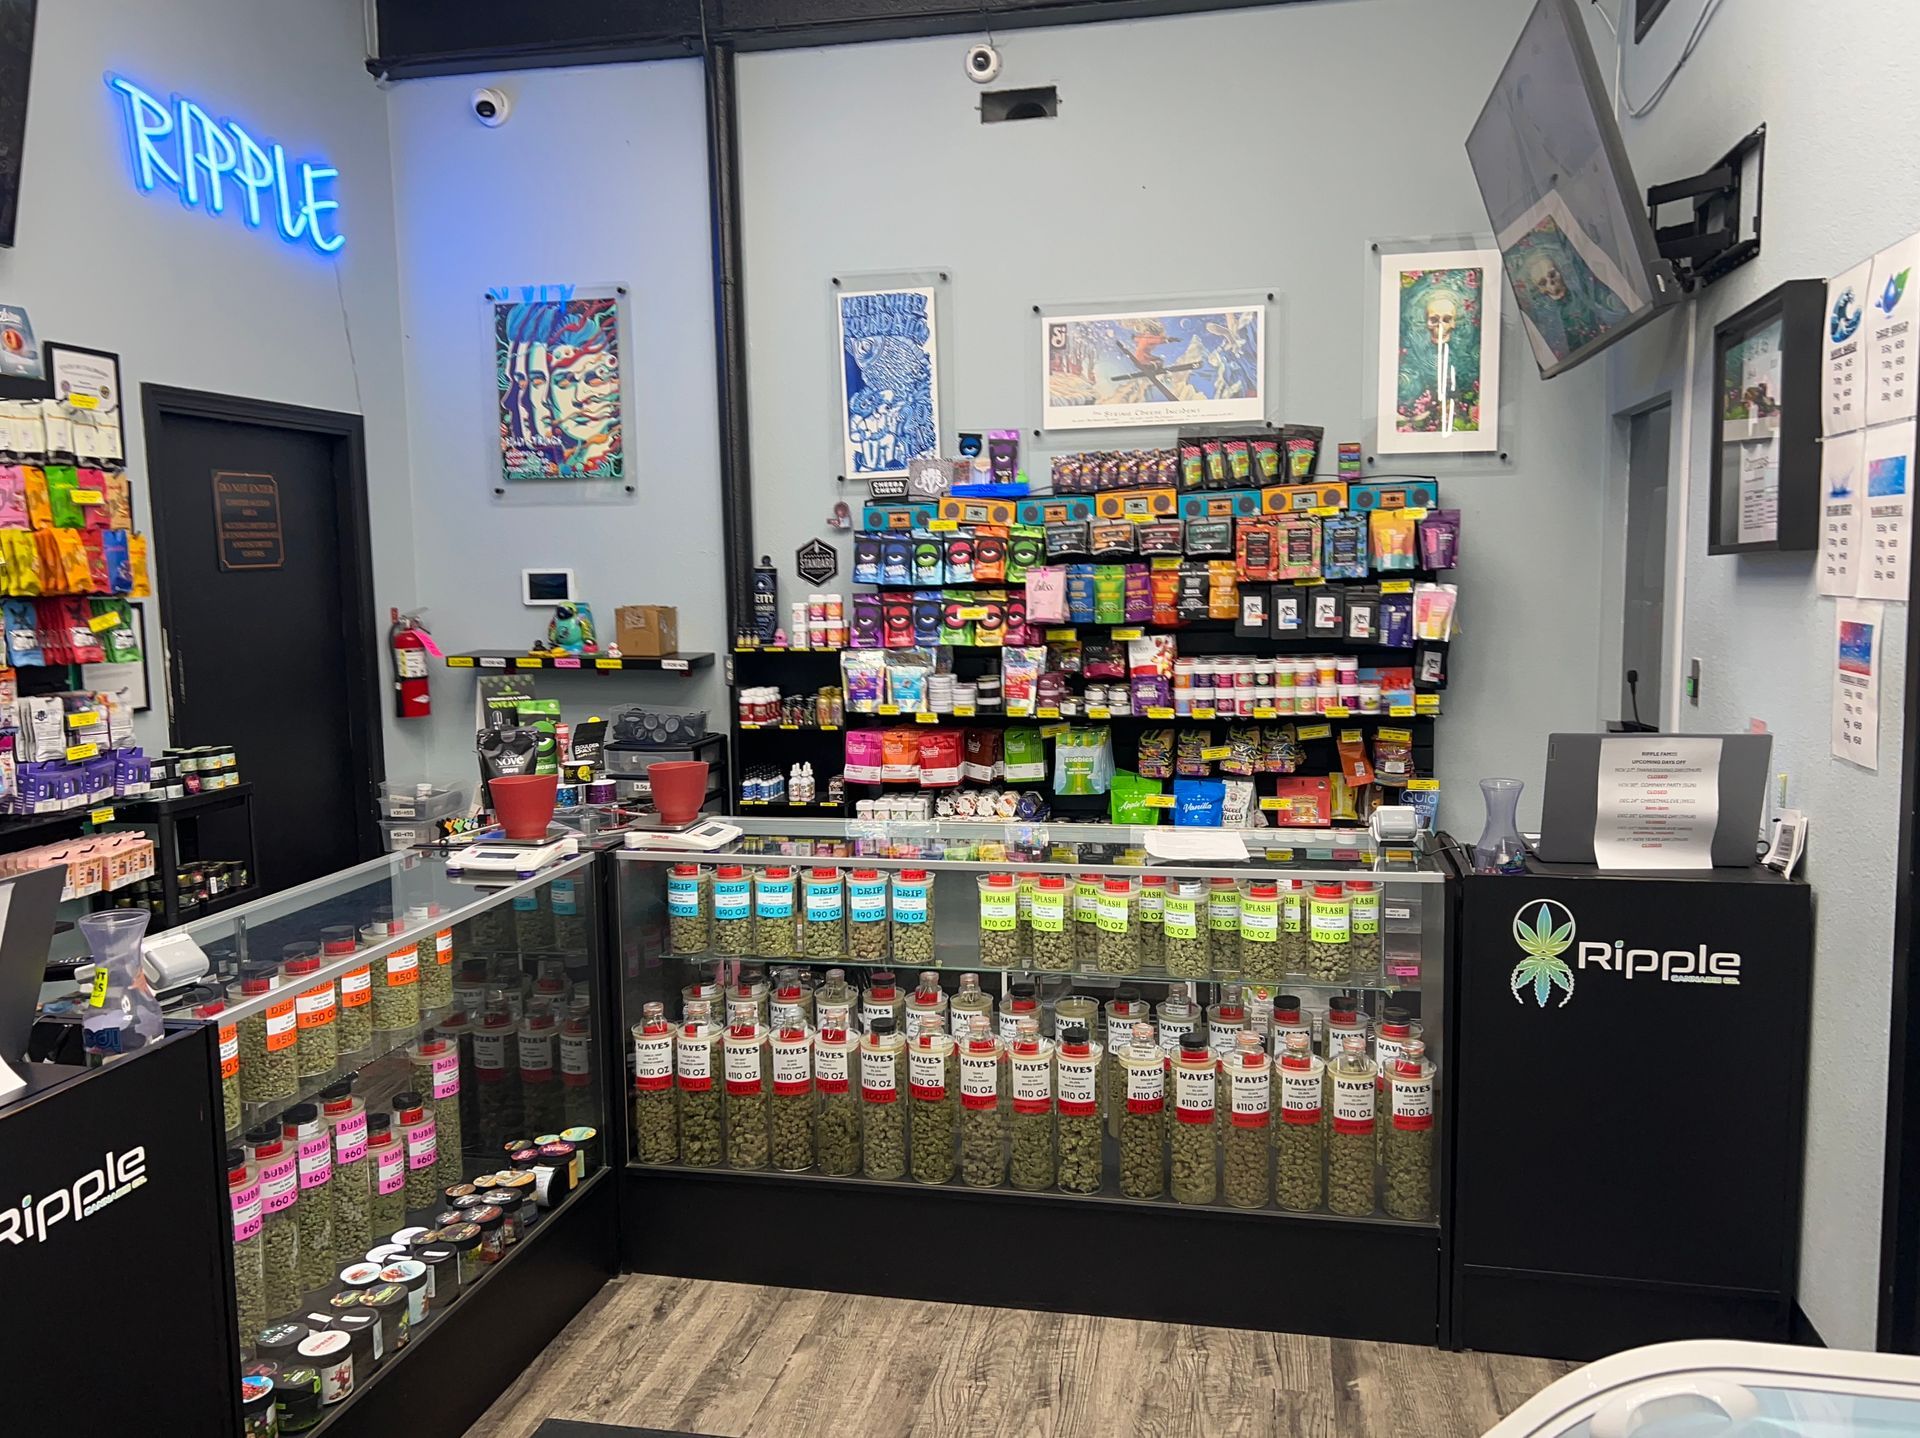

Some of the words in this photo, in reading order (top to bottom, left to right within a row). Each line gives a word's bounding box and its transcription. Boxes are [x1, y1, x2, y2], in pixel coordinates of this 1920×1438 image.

[109, 75, 346, 253] RIPPLE
[1182, 801, 1213, 813] Vanilla
[669, 882, 692, 891] DRIP
[720, 884, 745, 893] DRIP
[763, 885, 788, 894] DRIP
[812, 886, 839, 895] DRIP
[857, 886, 883, 895] DRIP
[1080, 887, 1097, 896] SPLA
[896, 888, 923, 897] DRIP
[1140, 890, 1162, 899] PLASH
[985, 895, 1010, 903] SPLASH
[1034, 895, 1057, 904] SPLASH
[1098, 897, 1121, 908] SPLASH
[1210, 894, 1236, 903] SPLASH
[1353, 897, 1375, 905] LASH
[681, 906, 693, 914] OZ
[1165, 900, 1188, 910] SPLASH
[1245, 903, 1271, 913] SPLASH
[1316, 905, 1344, 914] SPLASH
[735, 907, 746, 916] OZ
[761, 907, 775, 915] $90
[776, 906, 788, 914] OZ
[812, 910, 827, 919] $90
[829, 908, 840, 918] OZ
[856, 911, 872, 919] $90
[874, 909, 885, 918] OZ
[1151, 911, 1164, 920] OZ
[895, 912, 909, 920] $90
[911, 912, 924, 921] OZ
[984, 919, 997, 928] $70
[1000, 919, 1012, 927] OZ
[1044, 921, 1057, 929] OZ
[1110, 920, 1124, 930] OZ
[1224, 920, 1237, 928] OZ
[1362, 922, 1375, 930] OZ
[1176, 928, 1189, 936] OZ
[1243, 929, 1255, 937] $70
[1256, 930, 1271, 939] OZ
[1315, 931, 1331, 940] $70
[1333, 931, 1346, 941] OZ
[1578, 939, 1742, 981] Ripple
[394, 971, 412, 982] $50
[350, 992, 367, 1003] $50
[865, 1007, 891, 1015] WAVES
[305, 1013, 325, 1024] $50
[1160, 1023, 1192, 1033] WAVES
[276, 1033, 293, 1045] $50
[637, 1041, 670, 1051] WAVES
[679, 1043, 708, 1052] WAVES
[726, 1046, 759, 1055] WAVES
[775, 1047, 808, 1055] WAVES
[1378, 1041, 1400, 1053] WAV
[815, 1049, 844, 1059] WAVES
[861, 1052, 894, 1062] WAVES
[910, 1054, 941, 1064] WAVES
[962, 1058, 996, 1068] WAVES
[1014, 1062, 1049, 1072] WAVES
[640, 1068, 655, 1076] $110
[657, 1066, 670, 1074] OZ
[679, 1067, 691, 1076] $110
[692, 1068, 706, 1077] OZ
[1059, 1063, 1093, 1074] WAVES
[1130, 1067, 1163, 1077] WAVES
[728, 1072, 742, 1080] $110
[744, 1071, 758, 1080] OZ
[777, 1073, 792, 1081] $110
[795, 1071, 807, 1080] OZ
[817, 1071, 829, 1080] $110
[831, 1071, 845, 1080] OZ
[1179, 1071, 1214, 1081] WAVES
[1234, 1074, 1268, 1084] WAVES
[863, 1078, 876, 1087] $110
[878, 1080, 892, 1088] OZ
[911, 1076, 925, 1086] $110
[926, 1079, 940, 1087] OZ
[1285, 1077, 1320, 1087] WAVES
[1337, 1080, 1375, 1091] WAVES
[441, 1084, 456, 1095] $60
[963, 1084, 978, 1093] $110
[980, 1085, 993, 1094] OZ
[1018, 1089, 1034, 1098] $110
[1036, 1088, 1048, 1097] OZ
[1395, 1084, 1431, 1094] WAVES
[1061, 1090, 1076, 1100] $110
[1077, 1091, 1091, 1100] OZ
[1132, 1091, 1150, 1100] $110
[1152, 1090, 1163, 1099] OZ
[1181, 1099, 1199, 1108] $110
[1200, 1099, 1213, 1108] OZ
[1236, 1102, 1254, 1111] $110
[1256, 1101, 1268, 1110] OZ
[1285, 1100, 1303, 1110] $110
[1305, 1099, 1318, 1109] OZ
[1338, 1108, 1357, 1118] $110
[1359, 1109, 1372, 1118] OZ
[1397, 1107, 1416, 1116] $110
[1418, 1107, 1429, 1116] OZ
[345, 1147, 362, 1160] $60
[417, 1153, 432, 1165] $60
[308, 1171, 326, 1184] $60
[387, 1176, 401, 1190] $60
[0, 1145, 146, 1246] Ripple
[270, 1195, 289, 1209] $60
[243, 1219, 260, 1235] $60
